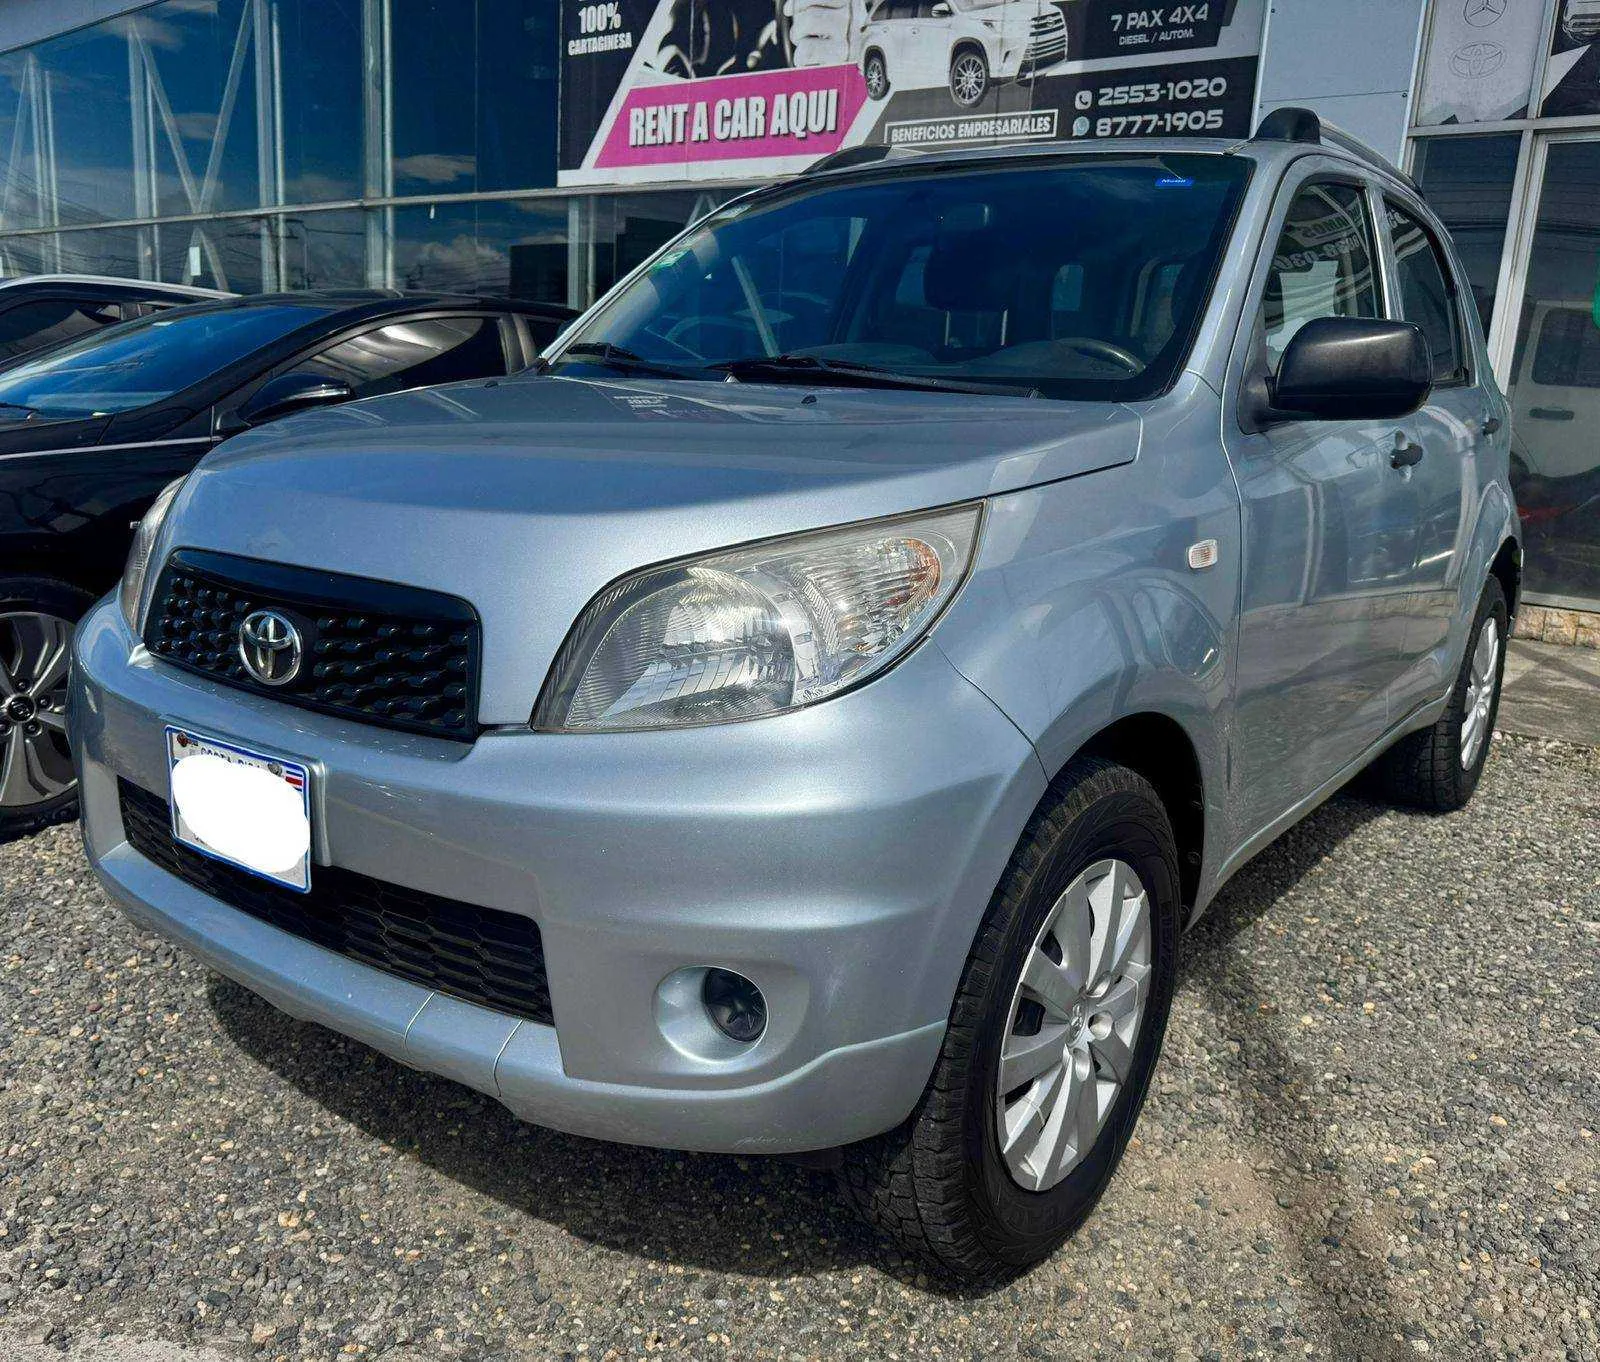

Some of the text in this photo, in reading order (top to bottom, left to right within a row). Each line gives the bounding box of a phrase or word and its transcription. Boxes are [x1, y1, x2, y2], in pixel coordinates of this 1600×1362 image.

[578, 1, 622, 34] 100%
[1110, 3, 1209, 32] 7 PAX 4X4
[567, 32, 632, 56] CARTAGINESA
[1118, 34, 1150, 46] DIESEL
[1158, 28, 1195, 42] AUTOM.
[1098, 77, 1227, 106] 2553-1020
[628, 88, 839, 147] RENT A CAR AQUI
[891, 116, 1051, 143] BENEFICIOS EMPRESARIALES
[1096, 109, 1223, 137] 8777-1905
